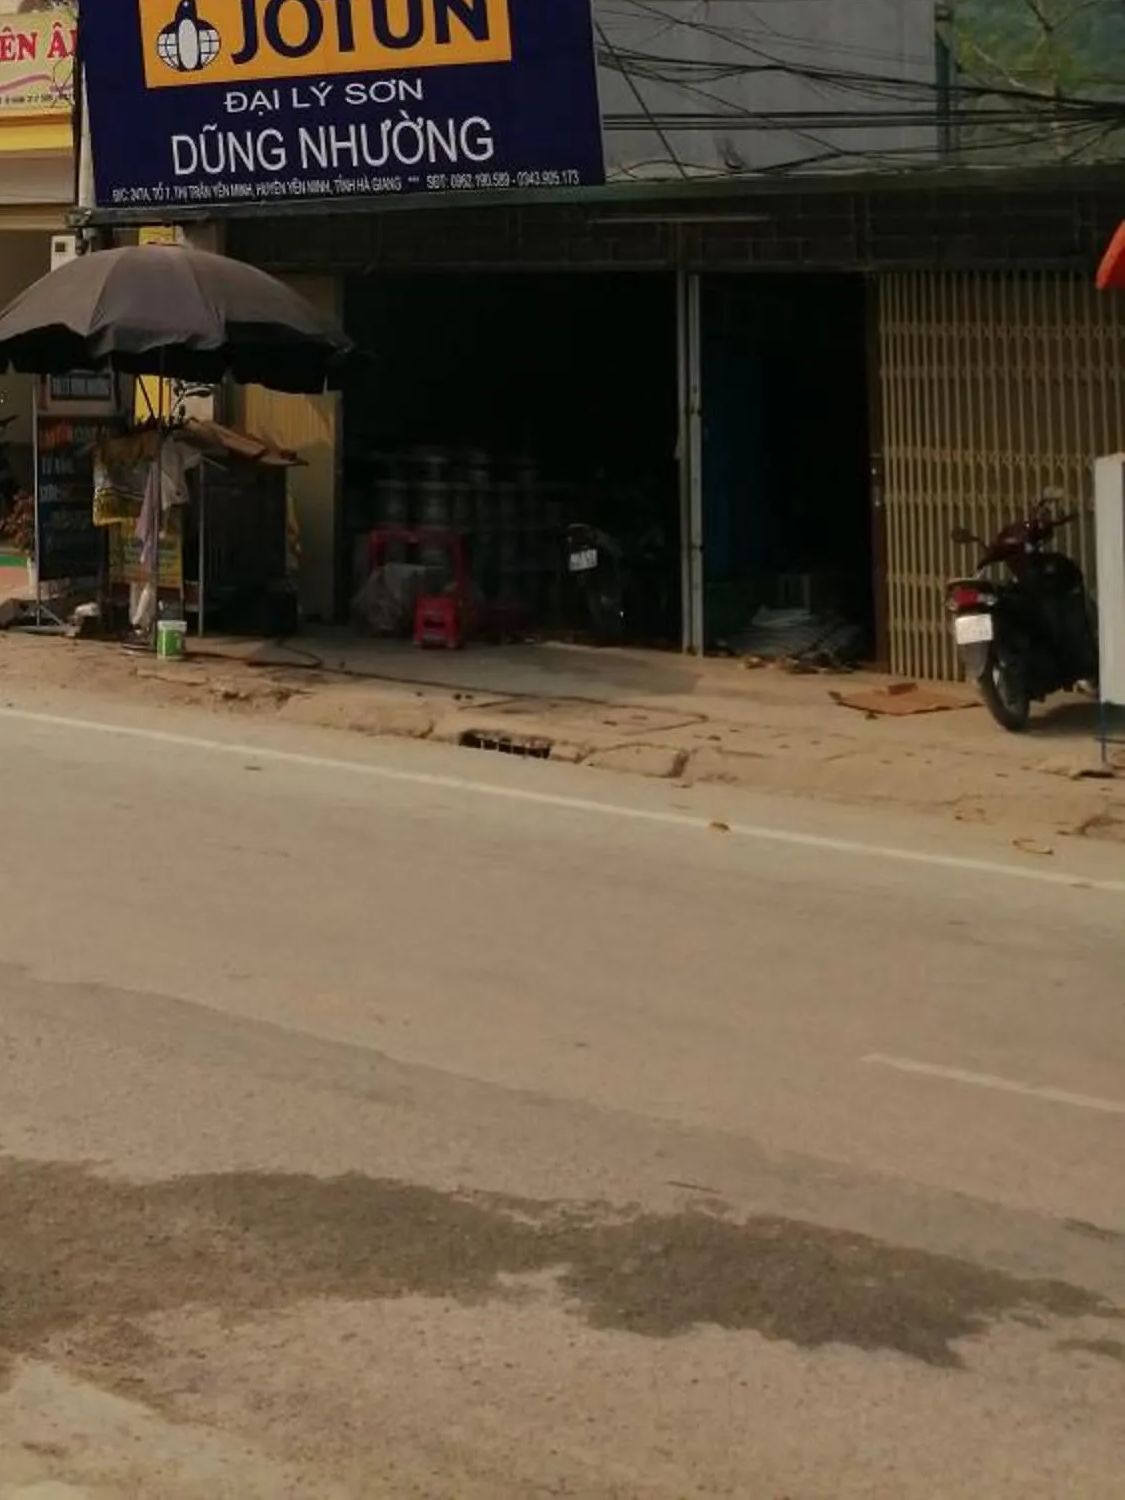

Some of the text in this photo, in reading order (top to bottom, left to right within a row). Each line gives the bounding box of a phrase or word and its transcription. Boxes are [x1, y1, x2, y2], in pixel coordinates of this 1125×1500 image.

[224, 77, 424, 115] ĐẠI LÝ SƠN
[171, 109, 495, 176] DŨNG NHƯỜNG
